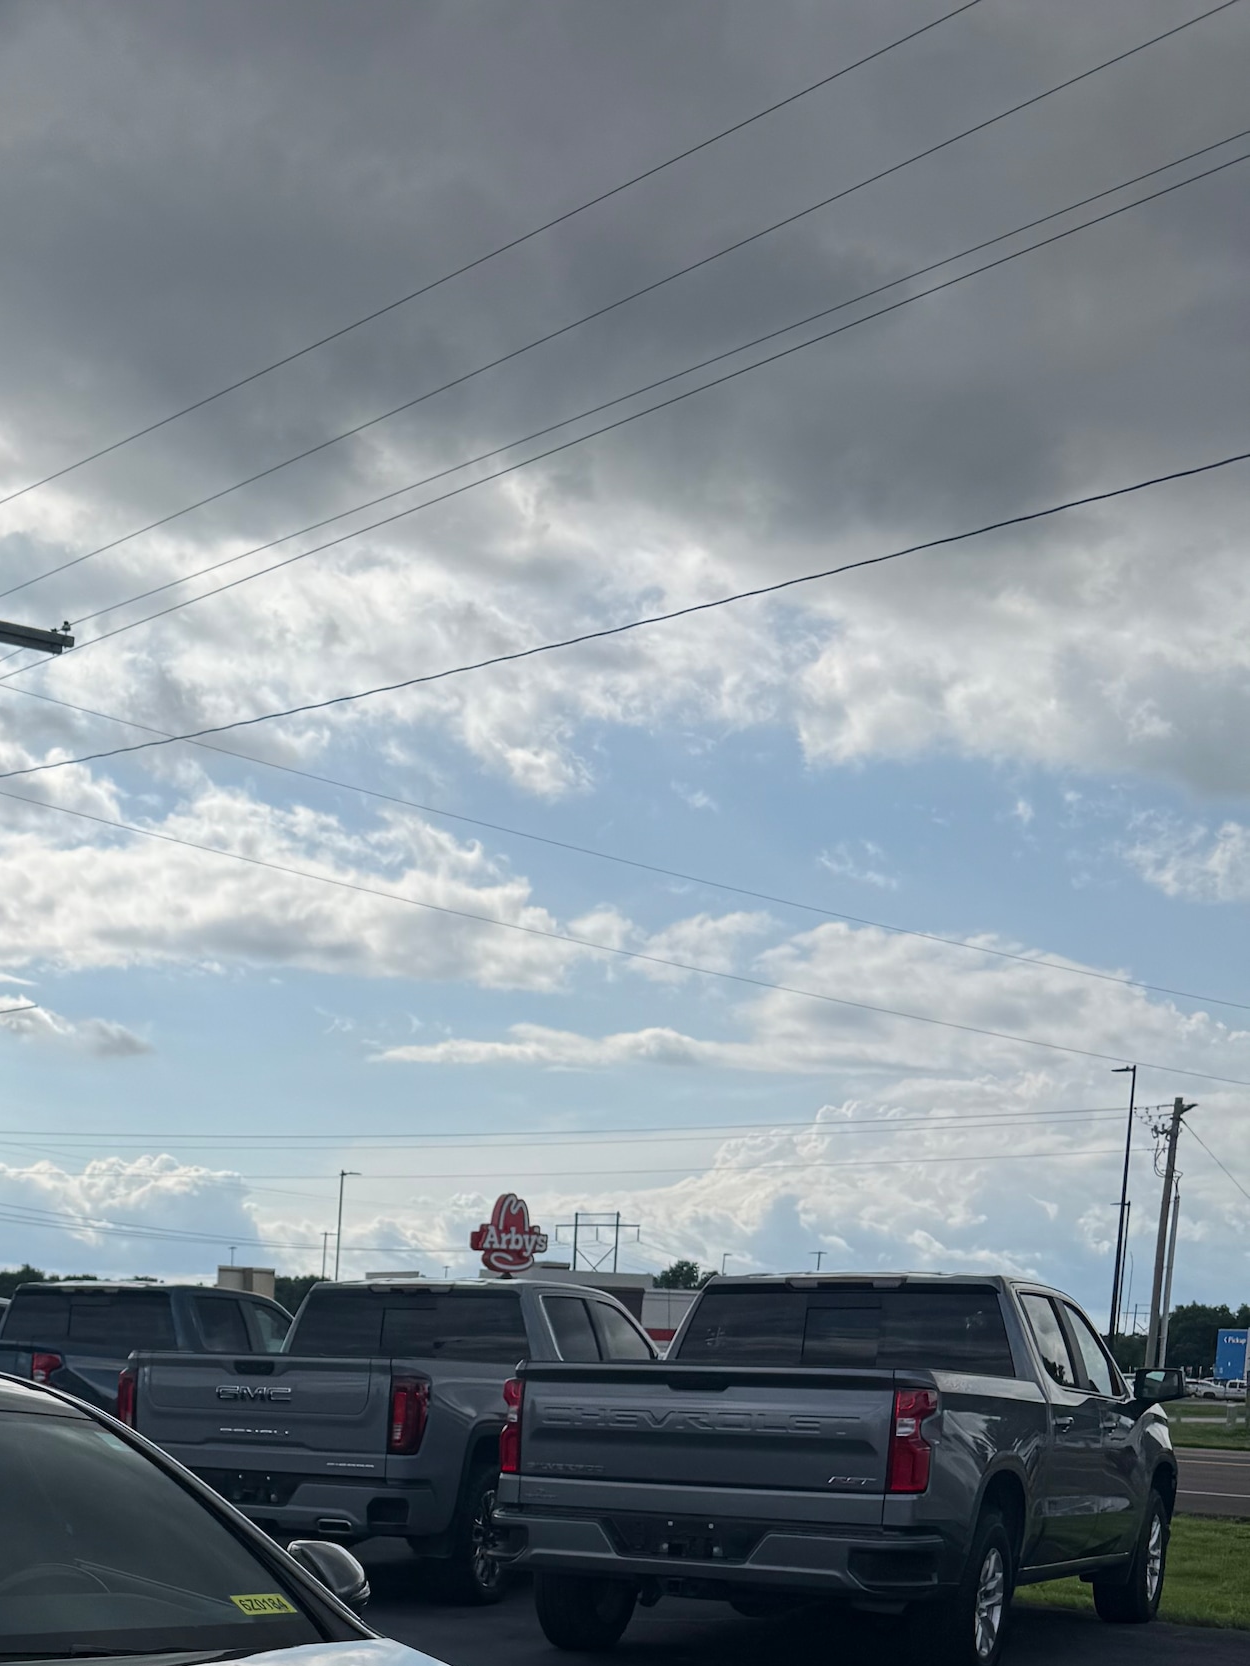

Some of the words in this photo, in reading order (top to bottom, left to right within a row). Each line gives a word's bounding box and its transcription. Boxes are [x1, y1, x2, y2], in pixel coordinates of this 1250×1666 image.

[483, 1224, 547, 1257] Arby's
[1228, 1336, 1246, 1345] Pickup
[216, 1385, 291, 1402] GMC
[542, 1406, 861, 1435] CHEVROLET
